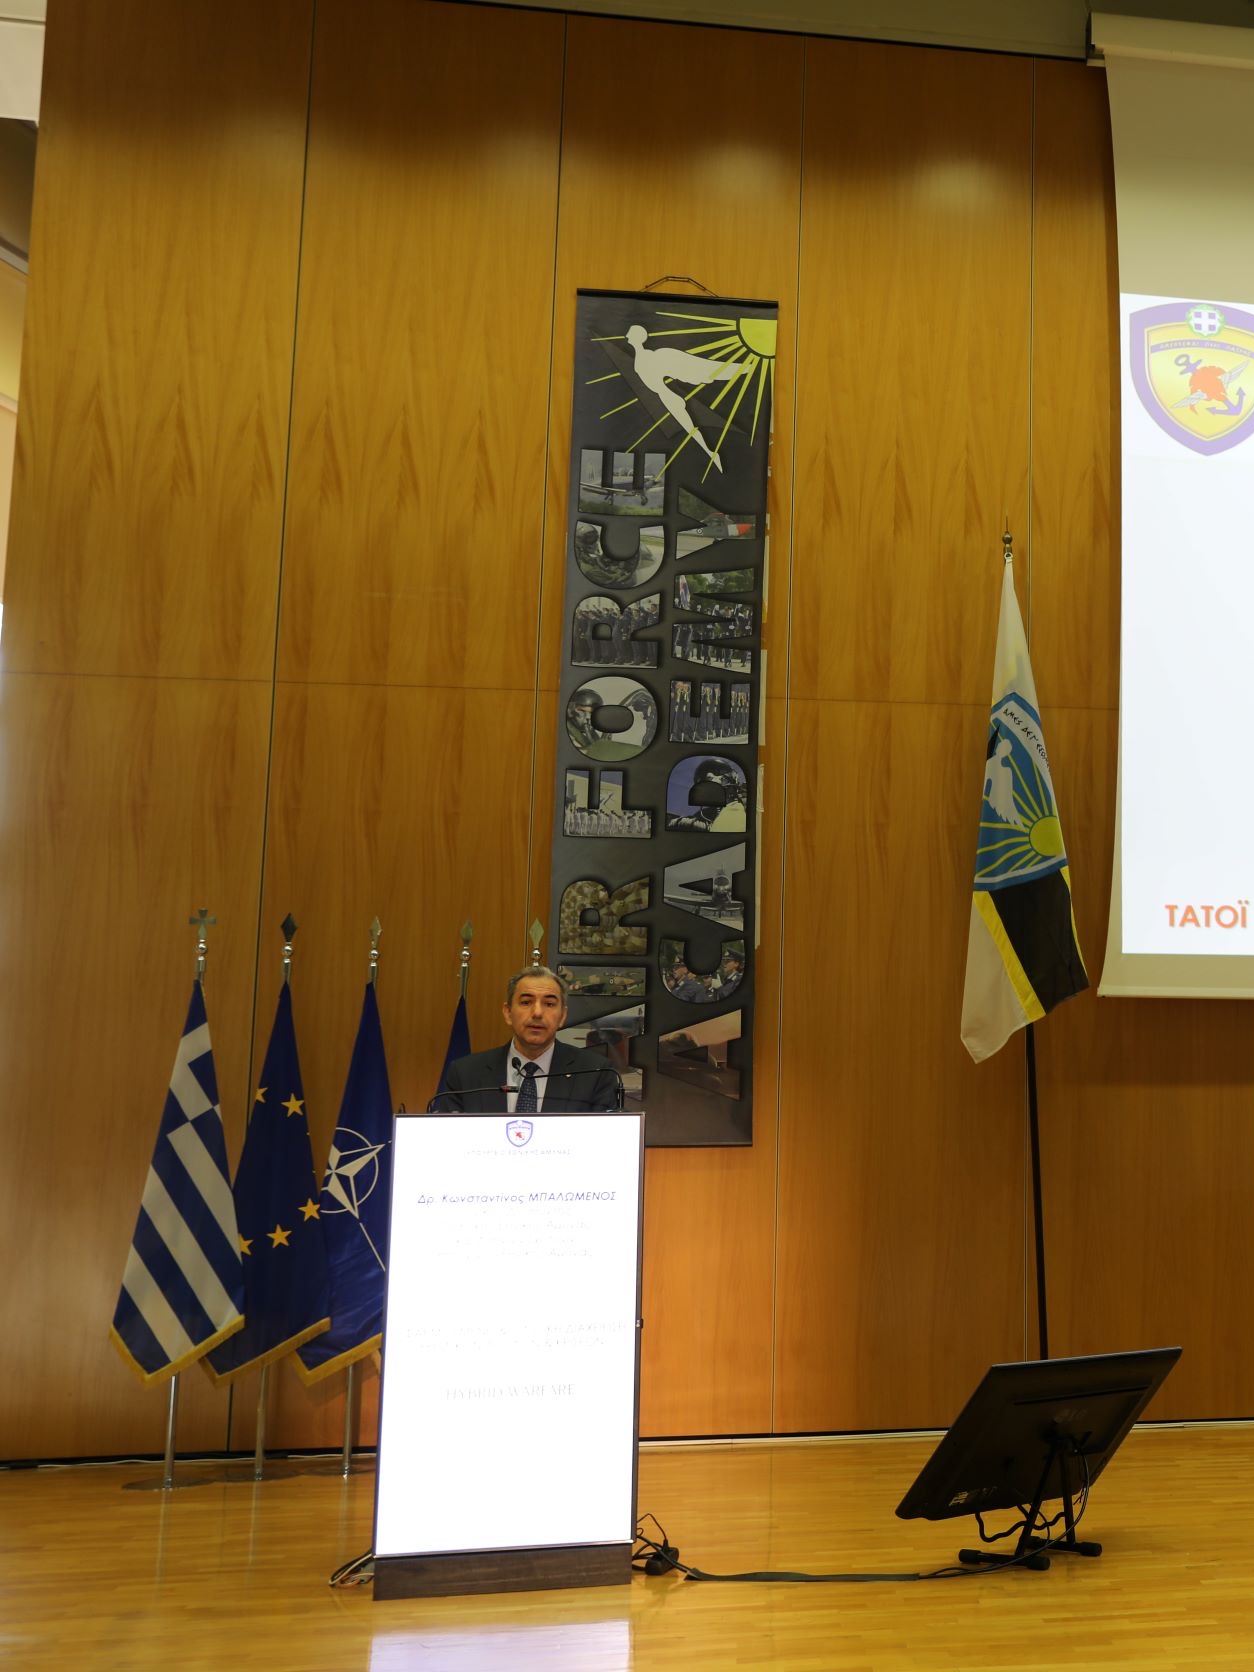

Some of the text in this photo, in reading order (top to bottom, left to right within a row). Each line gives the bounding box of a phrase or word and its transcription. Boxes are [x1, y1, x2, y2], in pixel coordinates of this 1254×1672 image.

[556, 448, 667, 1101] AIR FORCE
[657, 486, 757, 1101] ACADEMY
[1165, 900, 1250, 929] ΤΑΤΟΪ
[529, 1190, 617, 1202] ΜΠΑΛΩΜΕΝΟΣ
